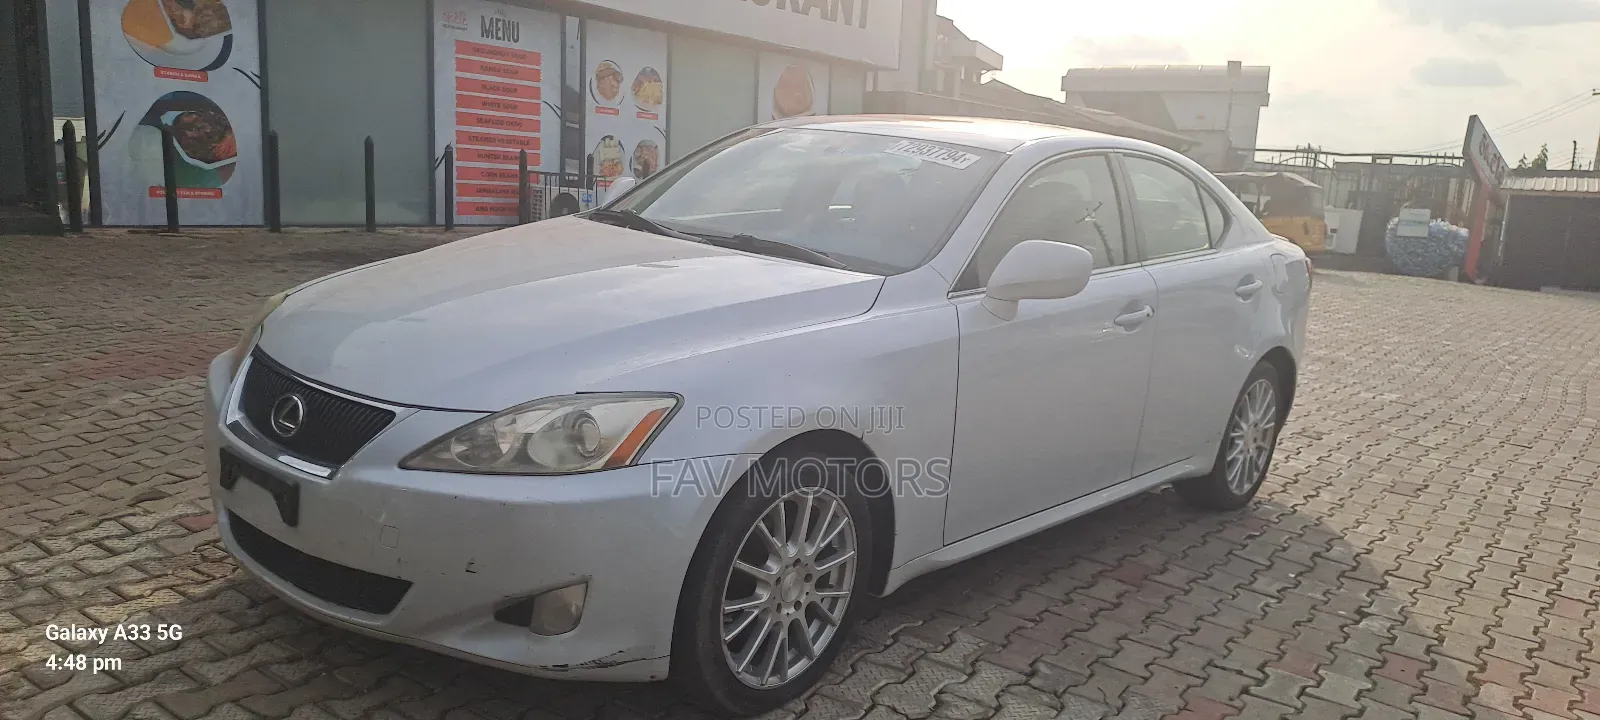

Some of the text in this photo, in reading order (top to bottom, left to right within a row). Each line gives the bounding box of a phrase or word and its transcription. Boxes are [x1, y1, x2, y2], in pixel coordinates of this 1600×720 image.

[480, 15, 520, 43] MENU
[481, 100, 501, 108] WHITE
[476, 117, 505, 126] SEAFOOD
[497, 137, 530, 146] VEGETABLE
